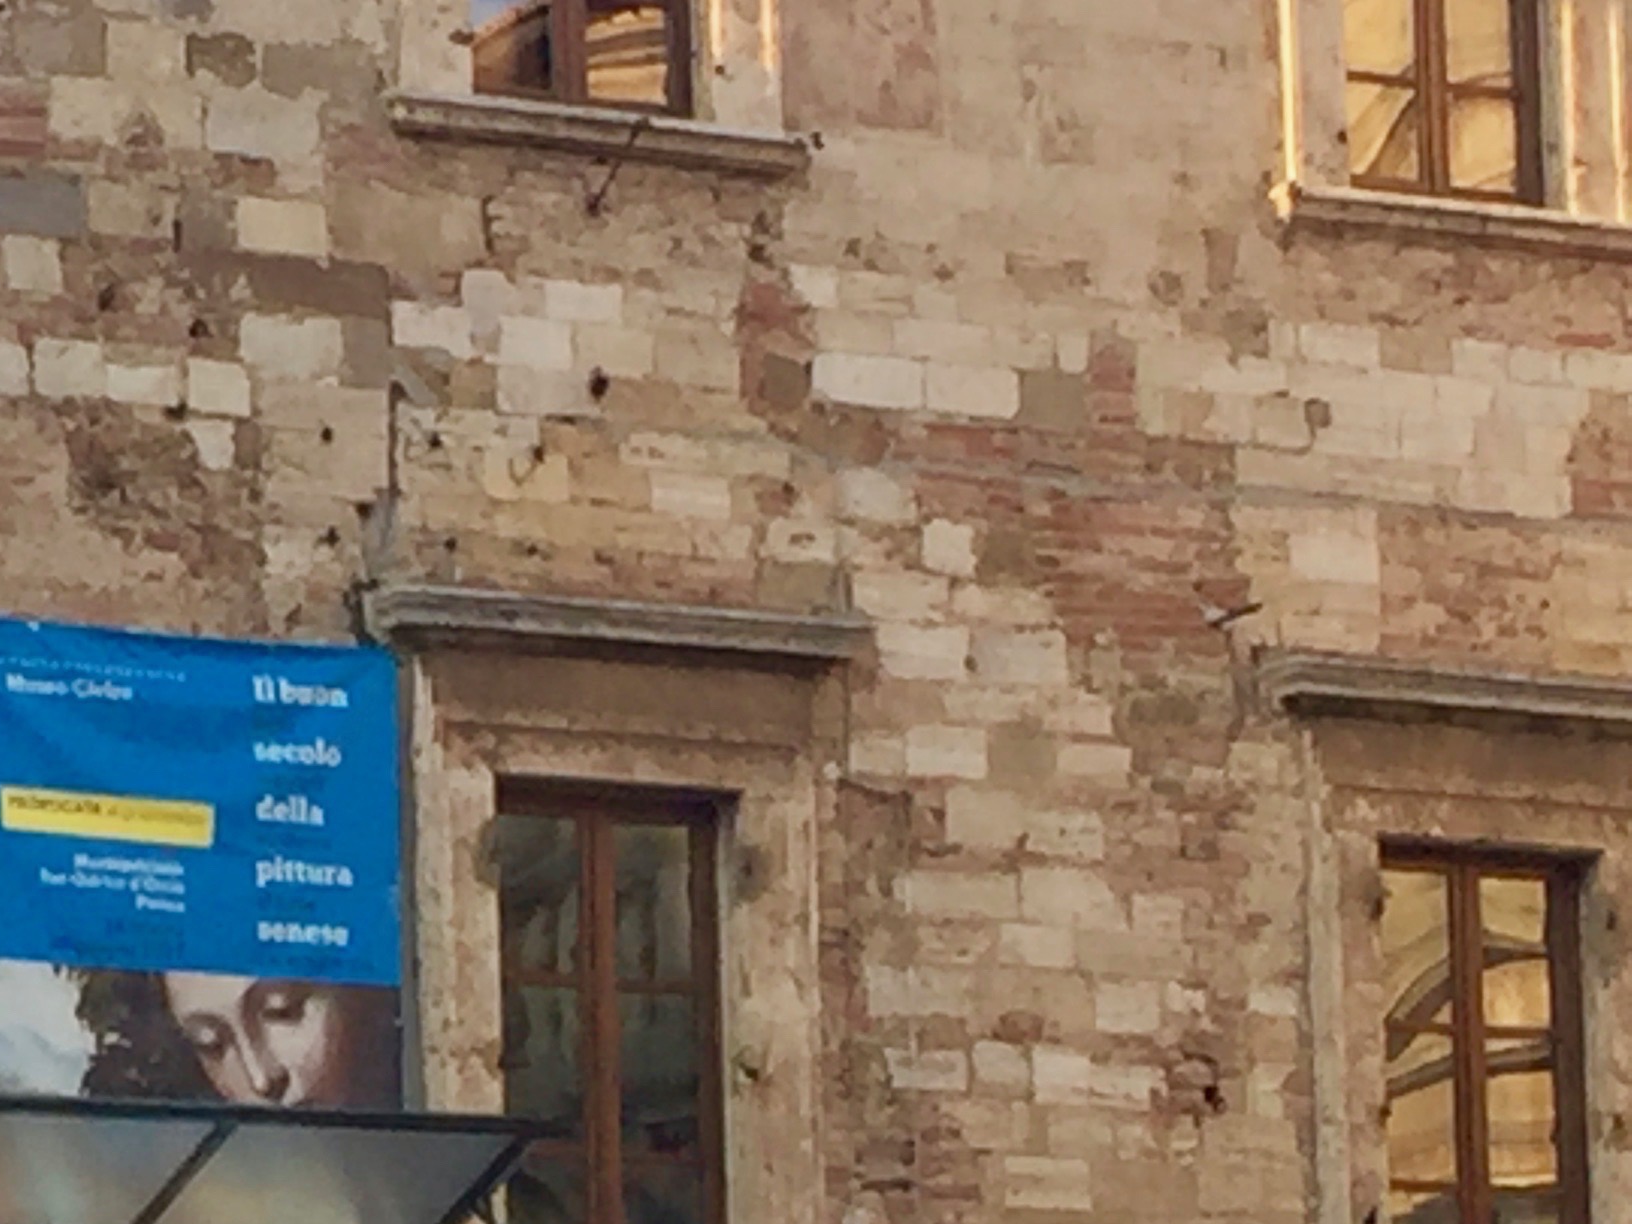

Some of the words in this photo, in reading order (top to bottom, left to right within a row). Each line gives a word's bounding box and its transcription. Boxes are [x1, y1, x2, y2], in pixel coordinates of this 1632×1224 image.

[278, 675, 349, 708] buon
[252, 736, 342, 768] secolo
[255, 792, 325, 827] della
[255, 854, 355, 889] pittura
[257, 921, 350, 948] senese
